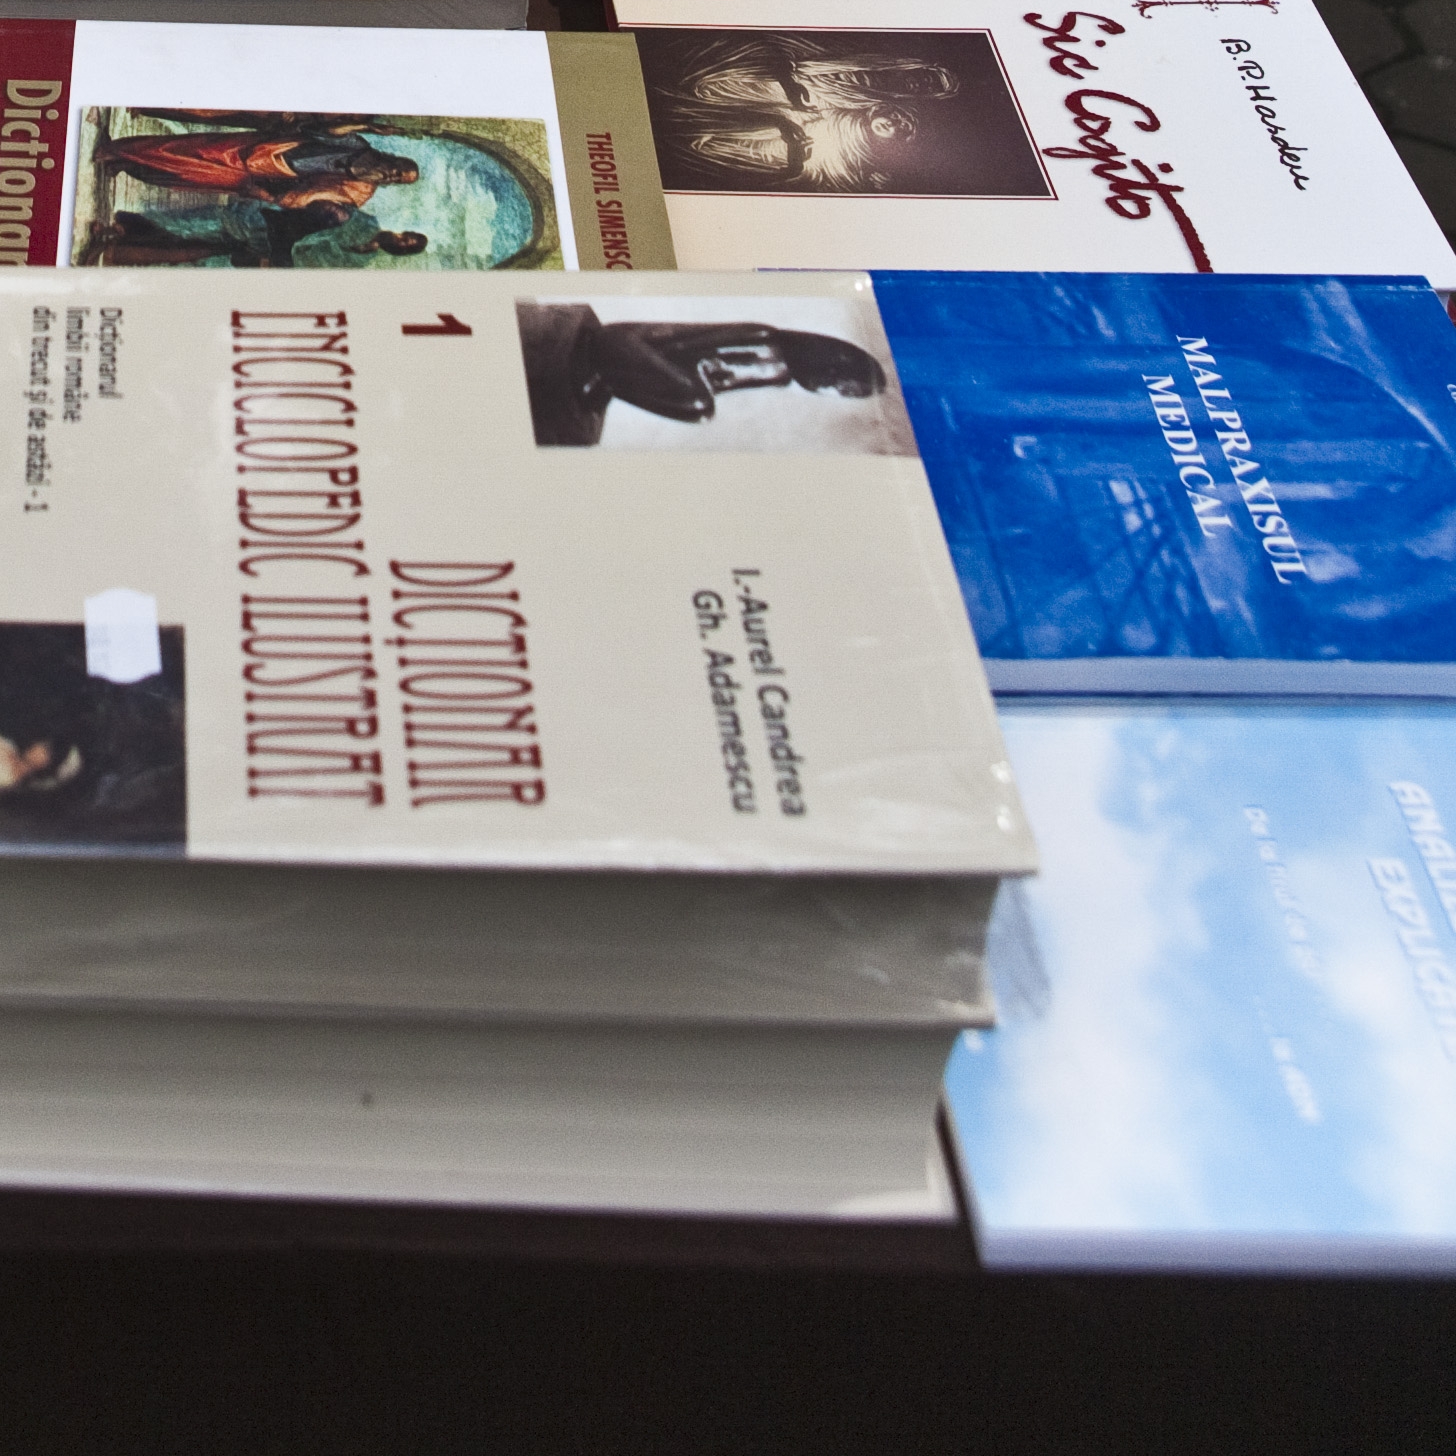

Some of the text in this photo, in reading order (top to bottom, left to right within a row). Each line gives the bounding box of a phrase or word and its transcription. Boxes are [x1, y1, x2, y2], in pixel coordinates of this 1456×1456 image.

[585, 131, 620, 194] THEOFIL
[1023, 11, 1215, 273] Sic Cogito
[29, 335, 52, 387] trecut
[31, 306, 54, 333] din
[63, 306, 89, 424] limbii române
[96, 306, 124, 400] Dicționarul
[401, 311, 473, 338] 1
[23, 389, 53, 405] și
[26, 407, 52, 430] de
[25, 432, 52, 488] astăzi
[1141, 372, 1236, 538] MEDICAL
[1175, 332, 1315, 586] MALPRAXISUL
[231, 310, 386, 807] ENCICLOPEDIC ILUSTRAT
[383, 559, 548, 807] DICȚIONAR
[691, 589, 757, 815] Gh. Adamescu
[730, 566, 809, 818] I.-Aurel Candrea
